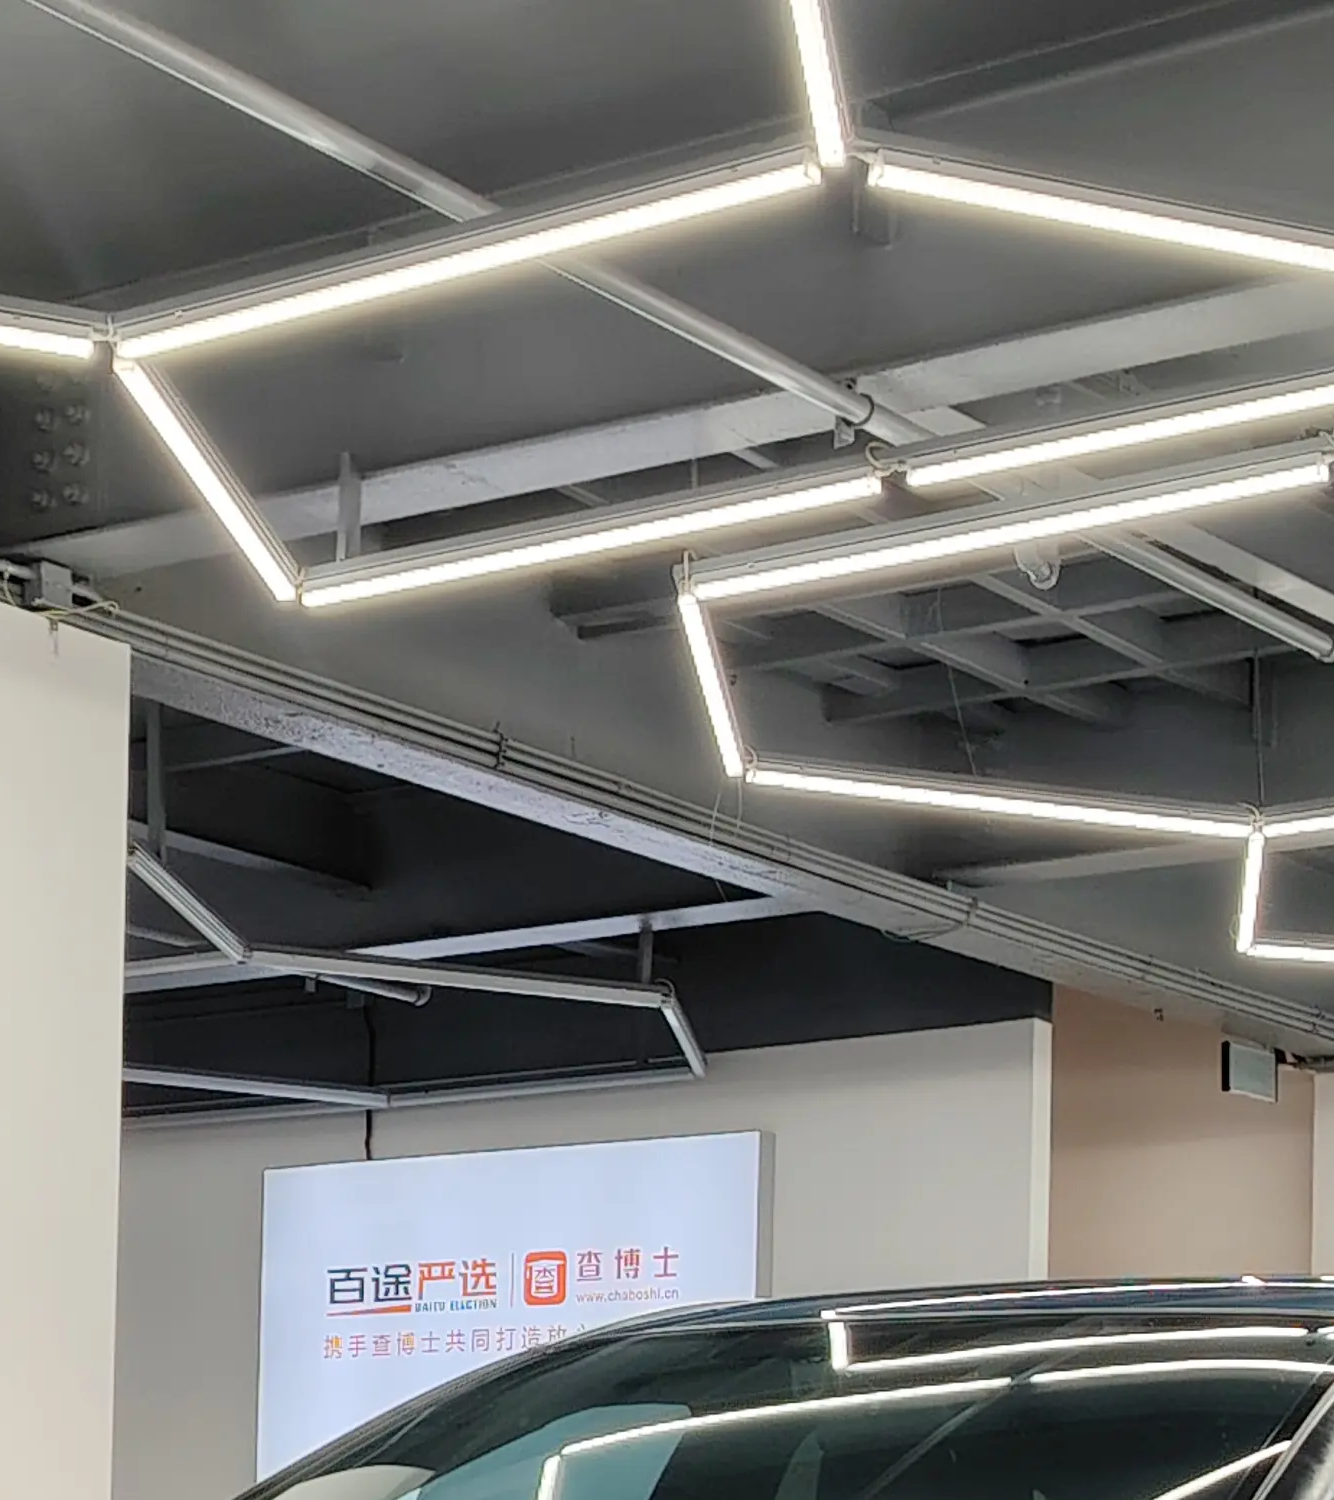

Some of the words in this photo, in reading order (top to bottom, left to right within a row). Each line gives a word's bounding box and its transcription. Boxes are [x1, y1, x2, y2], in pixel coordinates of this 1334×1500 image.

[327, 1258, 497, 1305] 百途严选
[576, 1246, 680, 1282] 查博士
[576, 1286, 680, 1304] www.chaboshi.cn
